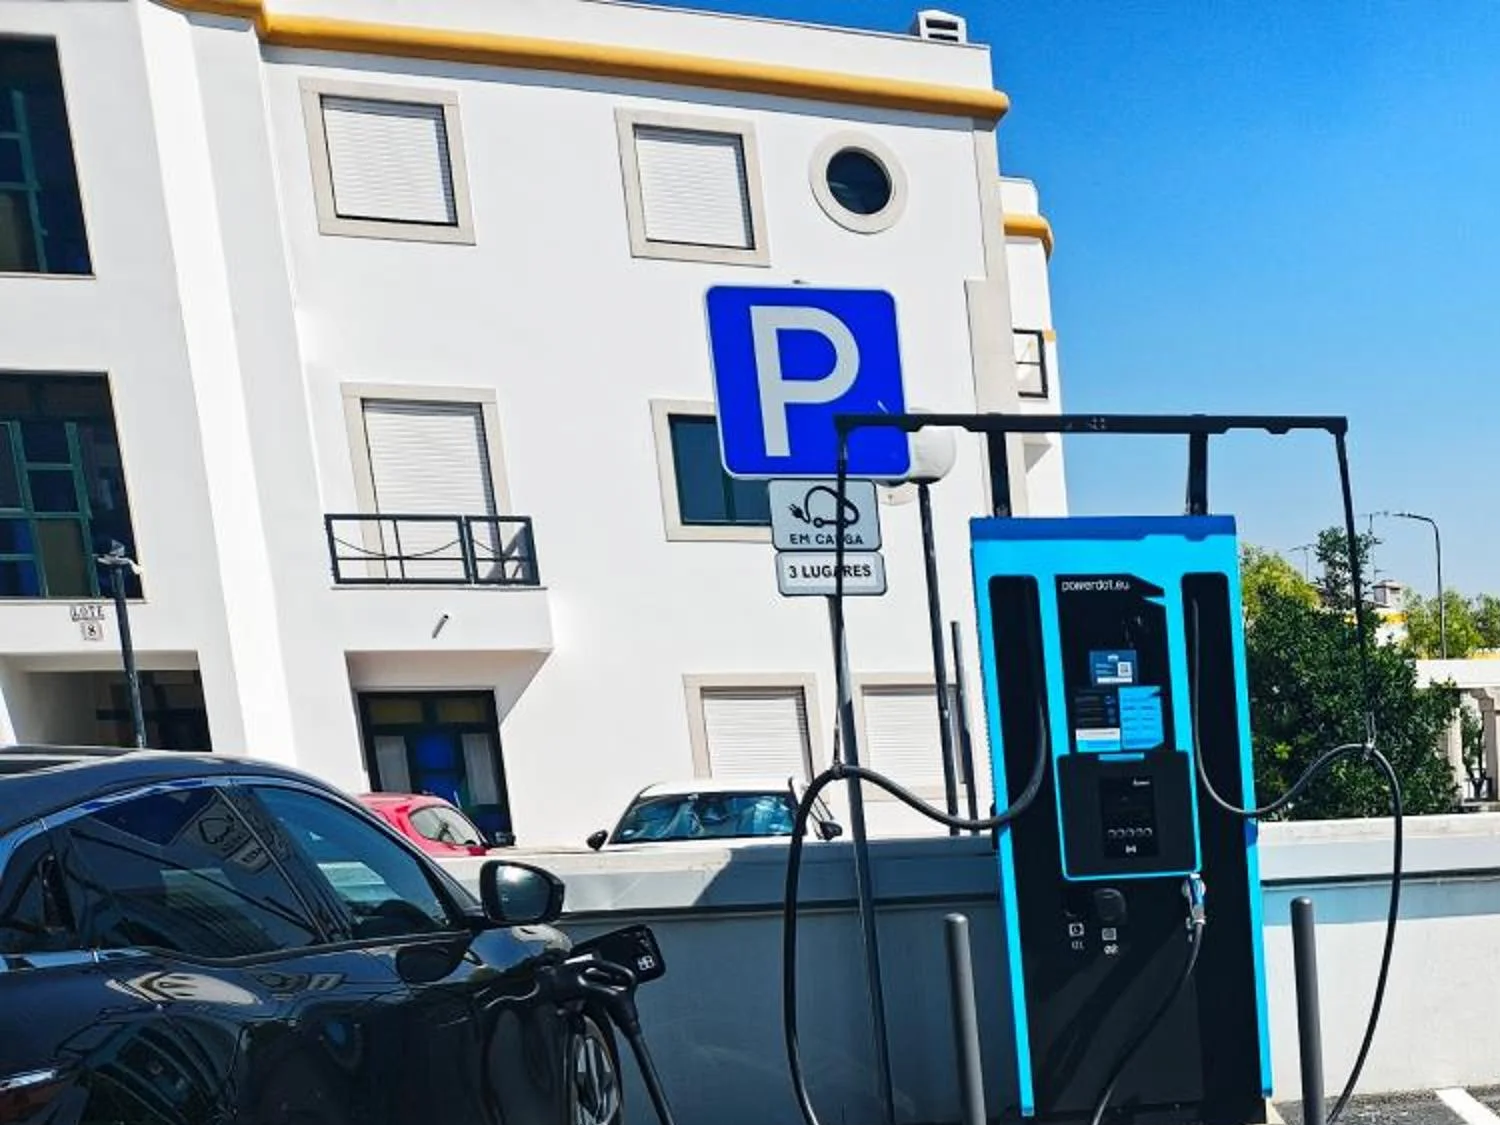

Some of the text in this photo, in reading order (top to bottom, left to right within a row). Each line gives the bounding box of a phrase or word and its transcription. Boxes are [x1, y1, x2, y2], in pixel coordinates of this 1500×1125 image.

[750, 304, 860, 457] P
[789, 533, 864, 545] EM CAGA
[789, 565, 797, 578] 3
[1061, 579, 1130, 593] powerdot.eu
